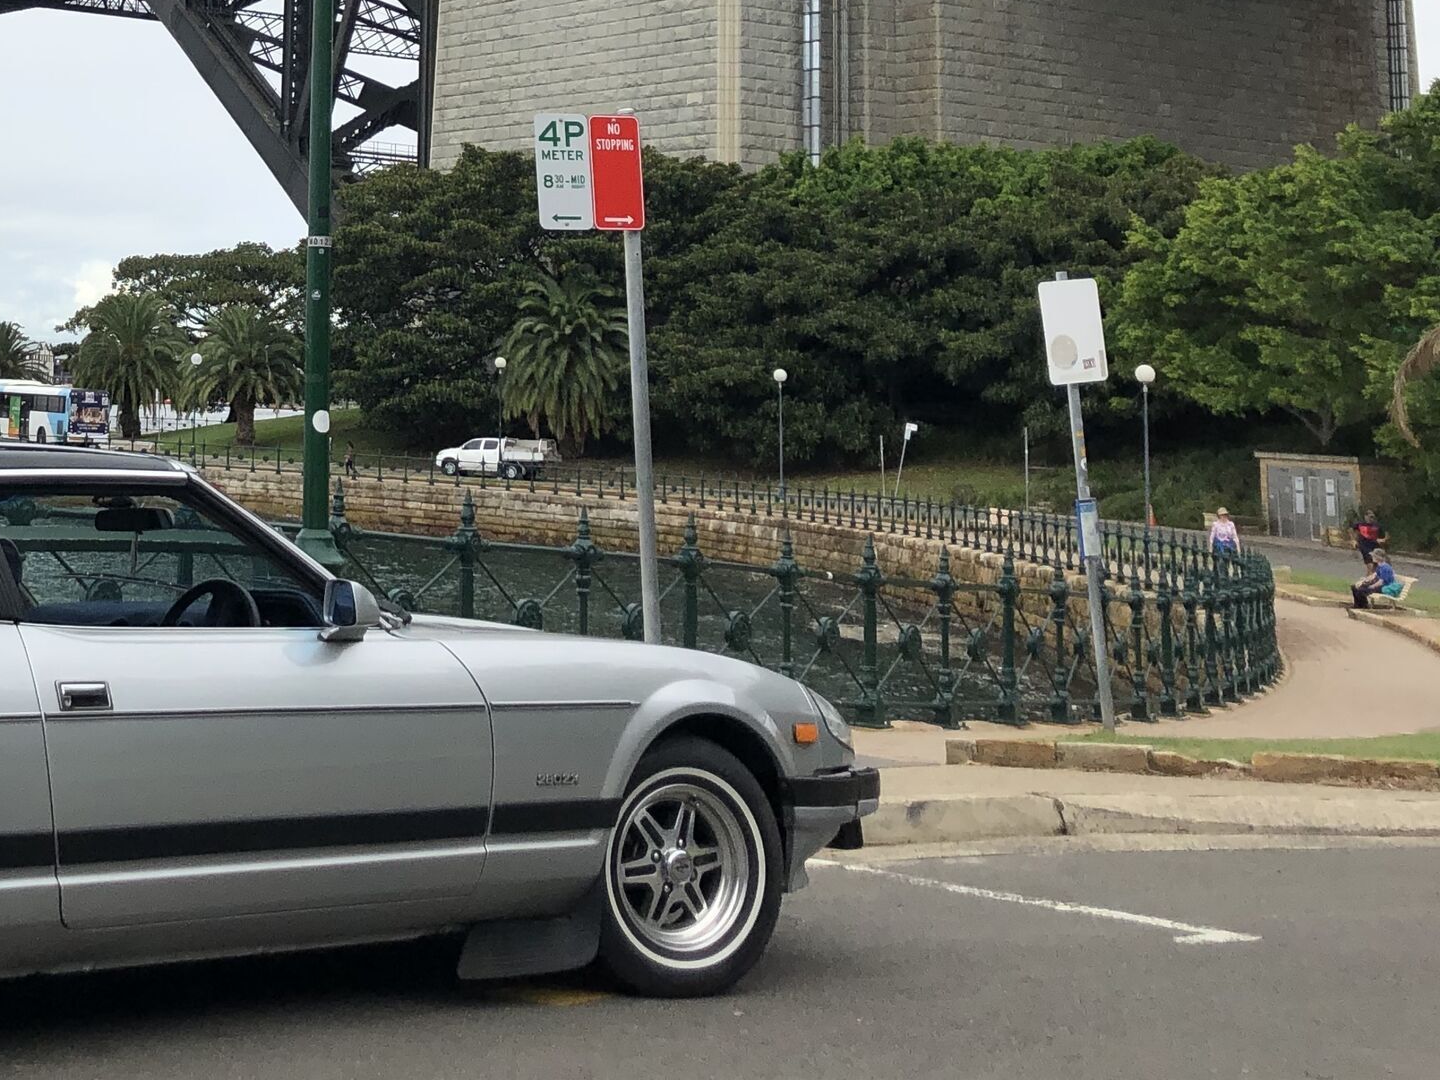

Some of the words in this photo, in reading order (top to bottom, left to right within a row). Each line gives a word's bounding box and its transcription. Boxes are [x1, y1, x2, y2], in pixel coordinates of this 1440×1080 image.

[538, 120, 584, 147] 4P
[607, 123, 620, 135] NO
[596, 138, 634, 151] STOPPING
[541, 149, 584, 161] METER
